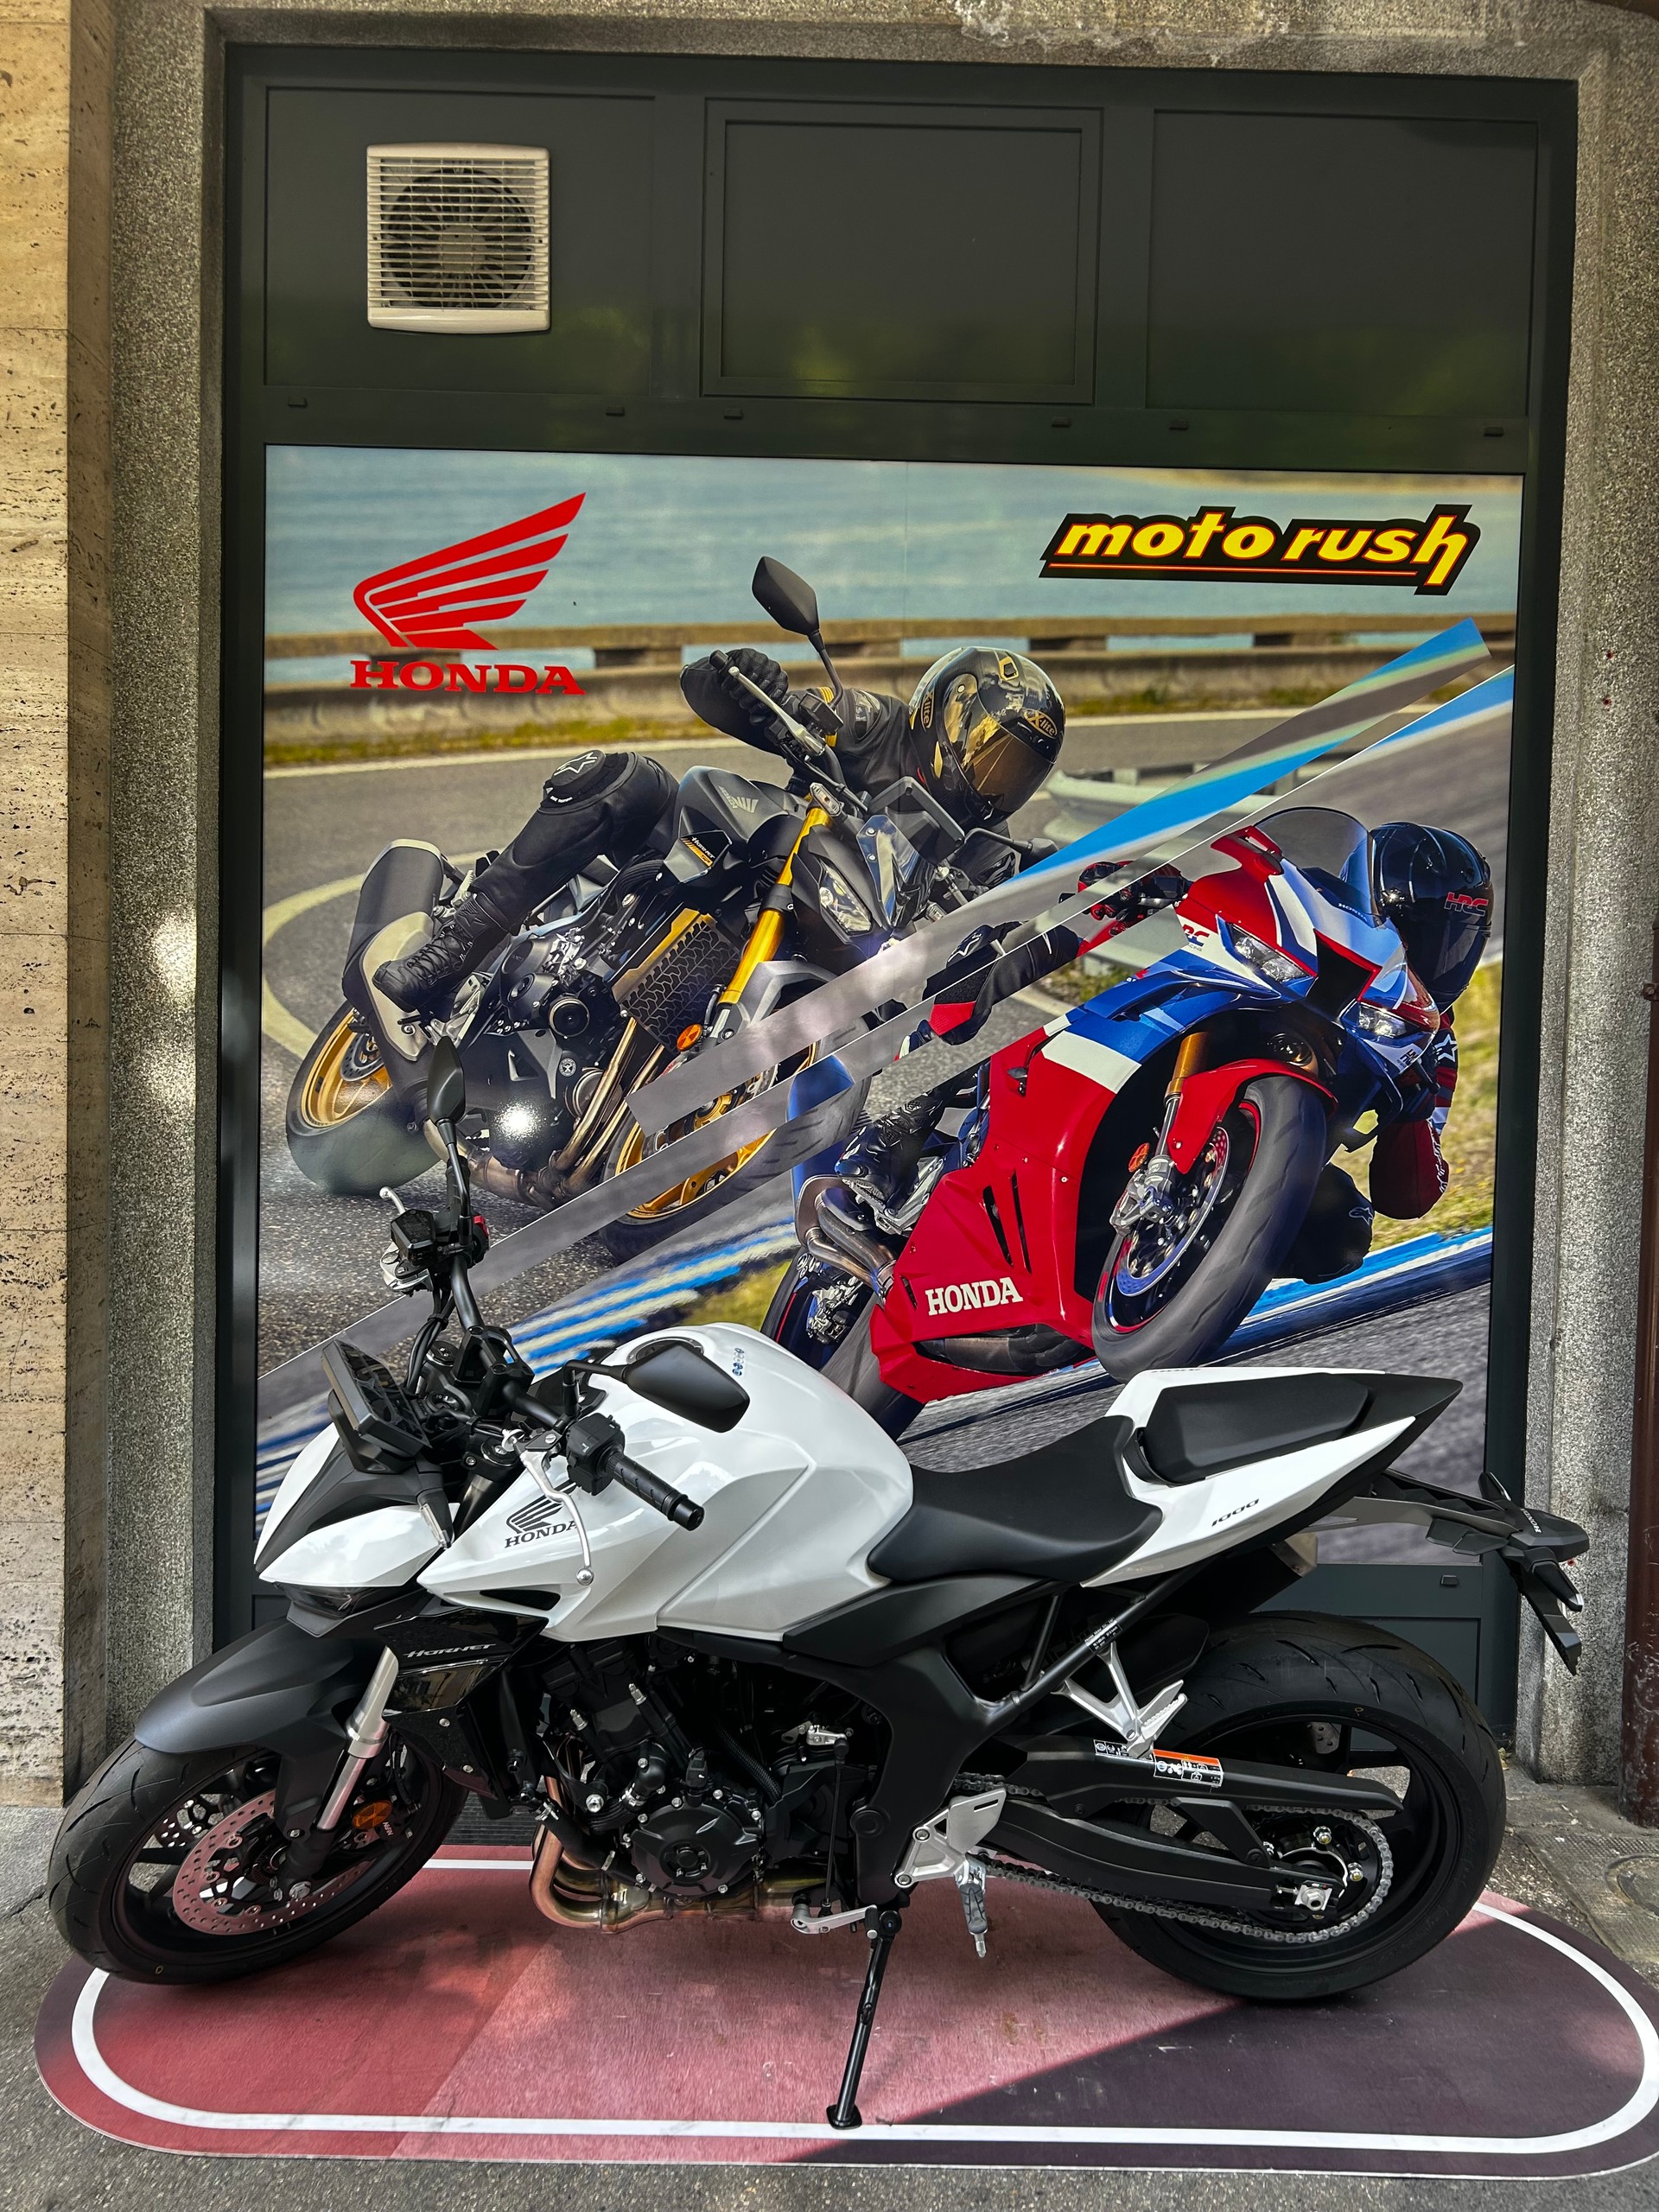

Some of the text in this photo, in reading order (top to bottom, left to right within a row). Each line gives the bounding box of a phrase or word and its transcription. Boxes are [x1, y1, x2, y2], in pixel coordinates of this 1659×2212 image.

[1053, 512, 1468, 586] moto rush
[350, 660, 586, 695] HONDA
[1027, 709, 1057, 736] X-lite
[1444, 892, 1489, 917] HRC
[1182, 924, 1210, 947] RC
[925, 1276, 1024, 1316] HONDA
[1211, 1497, 1260, 1527] 1000
[504, 1520, 578, 1548] HONDA
[403, 1643, 497, 1658] HORNET
